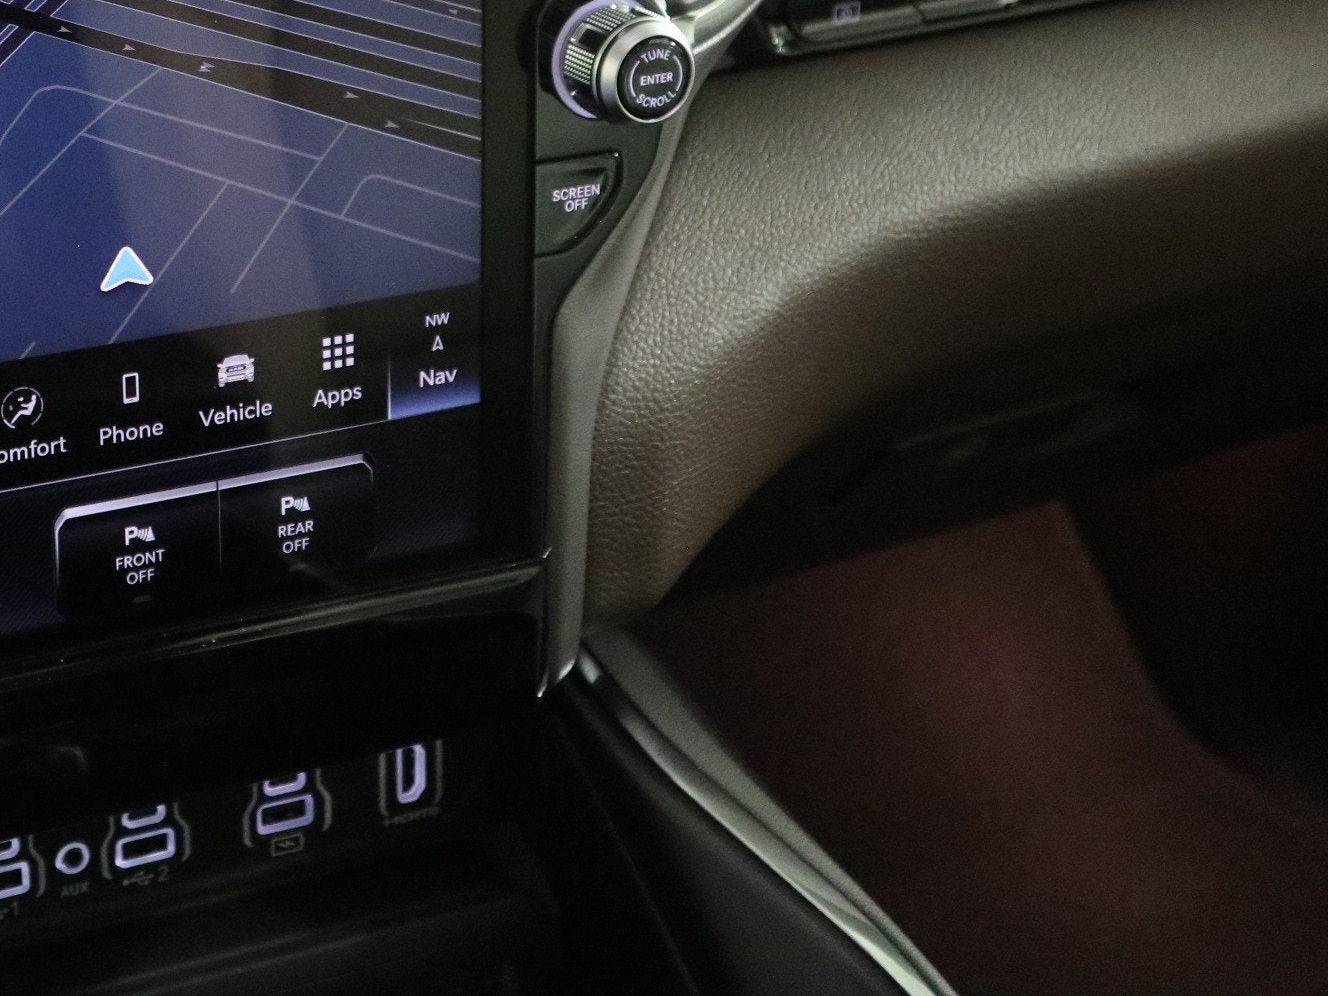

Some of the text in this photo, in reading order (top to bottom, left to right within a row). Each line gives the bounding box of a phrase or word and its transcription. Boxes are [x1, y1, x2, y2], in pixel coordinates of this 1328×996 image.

[640, 49, 672, 64] TUNE
[640, 72, 674, 87] ENTER
[636, 91, 677, 108] SCROLL
[552, 184, 601, 203] SCREEN
[565, 198, 589, 213] OFF
[425, 312, 451, 328] NW
[418, 368, 458, 388] Nav
[312, 384, 363, 409] Apps
[198, 400, 273, 427] Vehicle
[99, 421, 165, 446] Phone
[277, 520, 314, 539] REAR
[282, 537, 310, 554] OFF
[115, 549, 165, 570] FRONT
[126, 569, 155, 585] OFF
[61, 881, 89, 898] AUX
